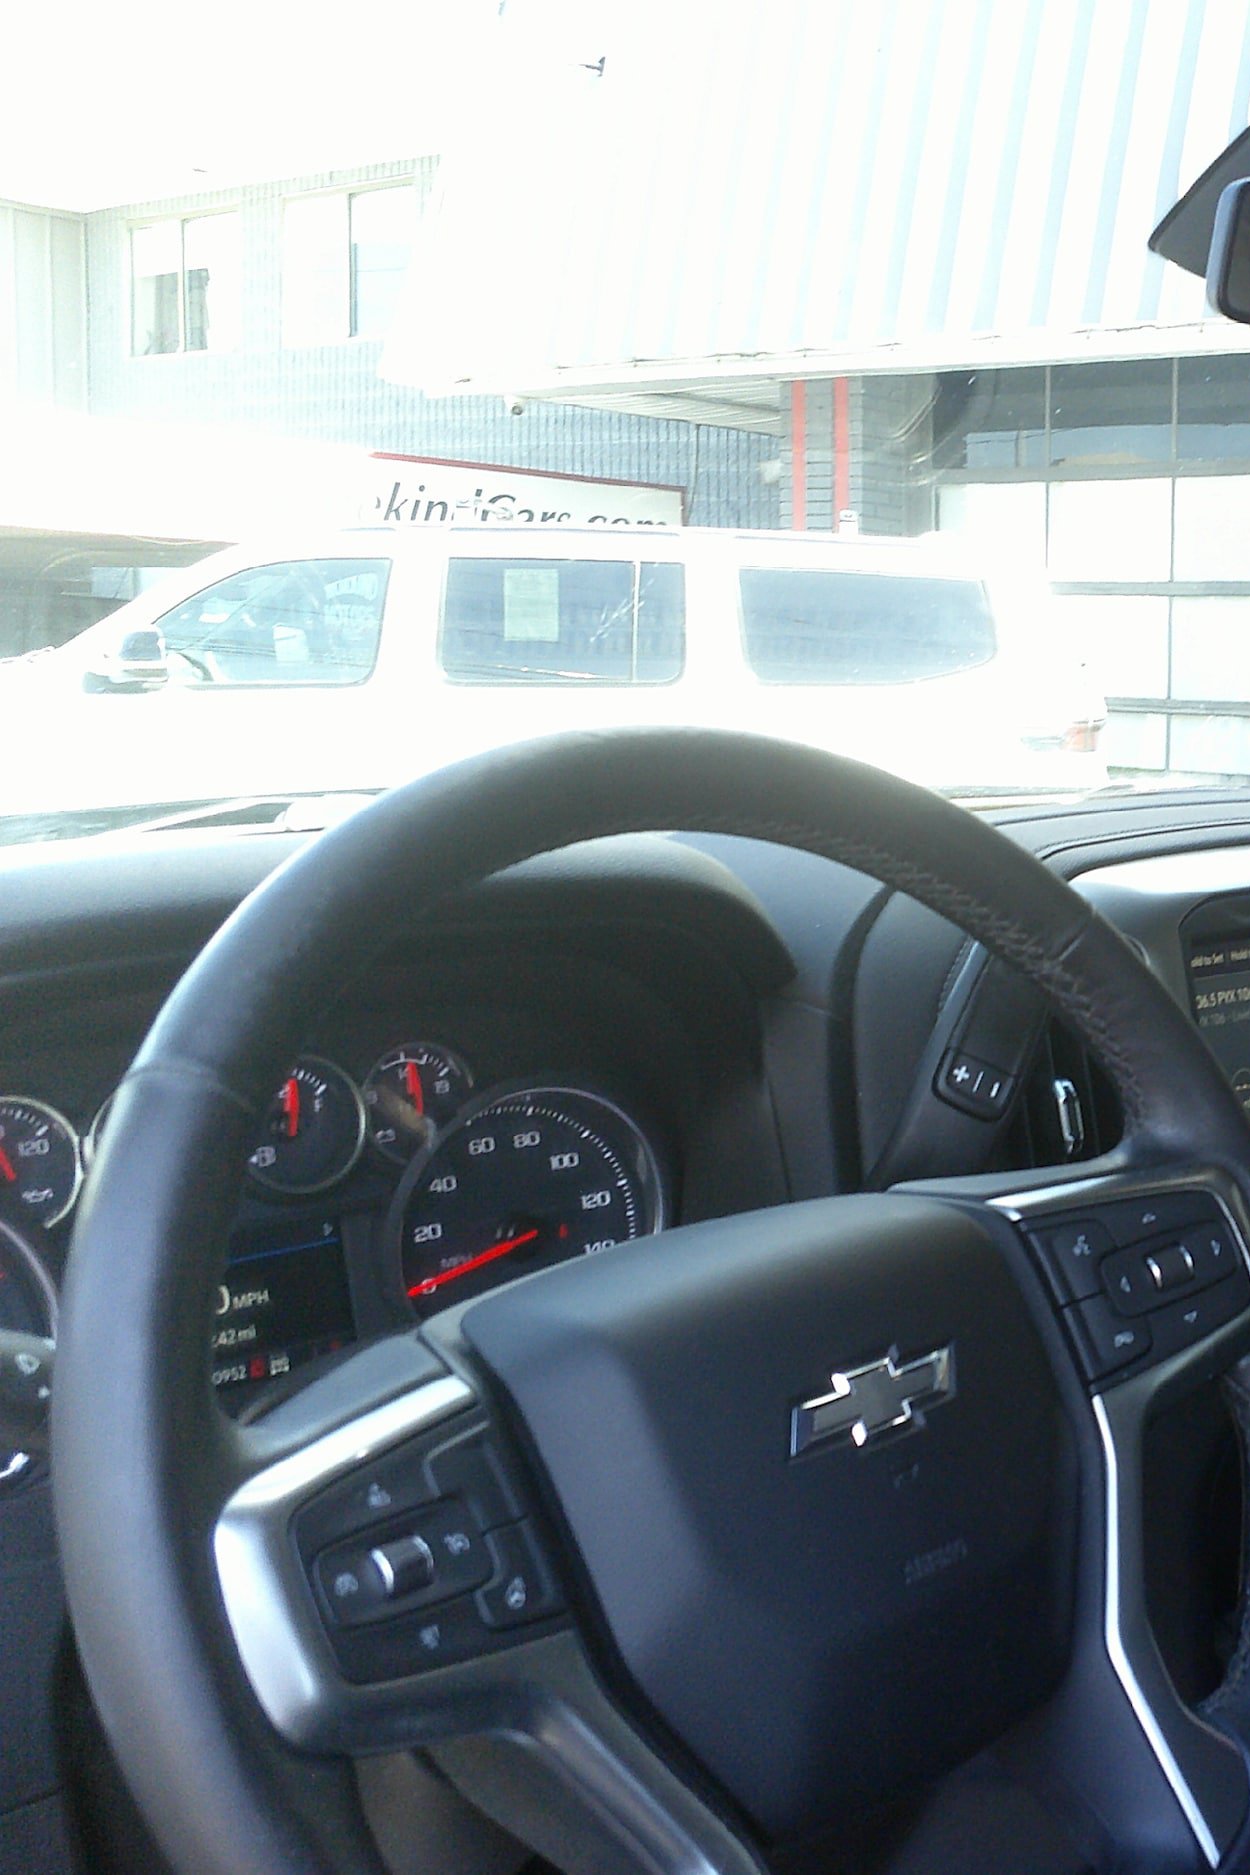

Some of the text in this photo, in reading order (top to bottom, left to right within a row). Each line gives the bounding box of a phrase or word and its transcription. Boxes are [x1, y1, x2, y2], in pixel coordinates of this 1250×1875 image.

[468, 1136, 496, 1156] 60
[512, 1131, 541, 1149] 80
[549, 1152, 580, 1171] 100
[429, 1174, 458, 1194] 40
[580, 1190, 612, 1210] 120
[414, 1222, 443, 1243] 20
